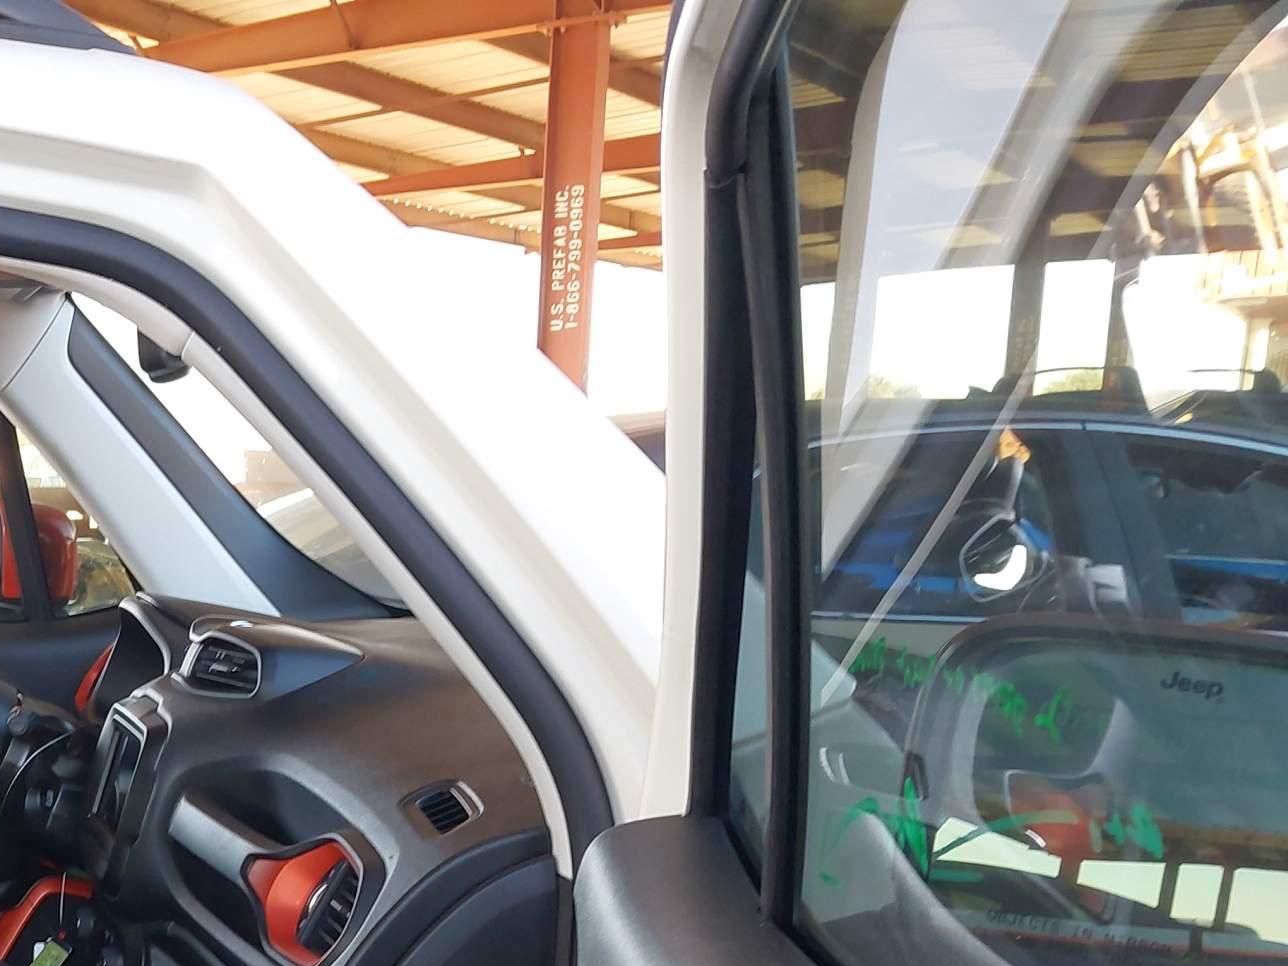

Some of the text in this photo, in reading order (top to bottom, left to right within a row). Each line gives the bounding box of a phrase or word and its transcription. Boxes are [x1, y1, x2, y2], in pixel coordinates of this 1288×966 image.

[549, 184, 570, 332] U.S. PREFAB INC.
[565, 184, 585, 329] 1-866-799-0969
[1160, 671, 1224, 699] Jeep
